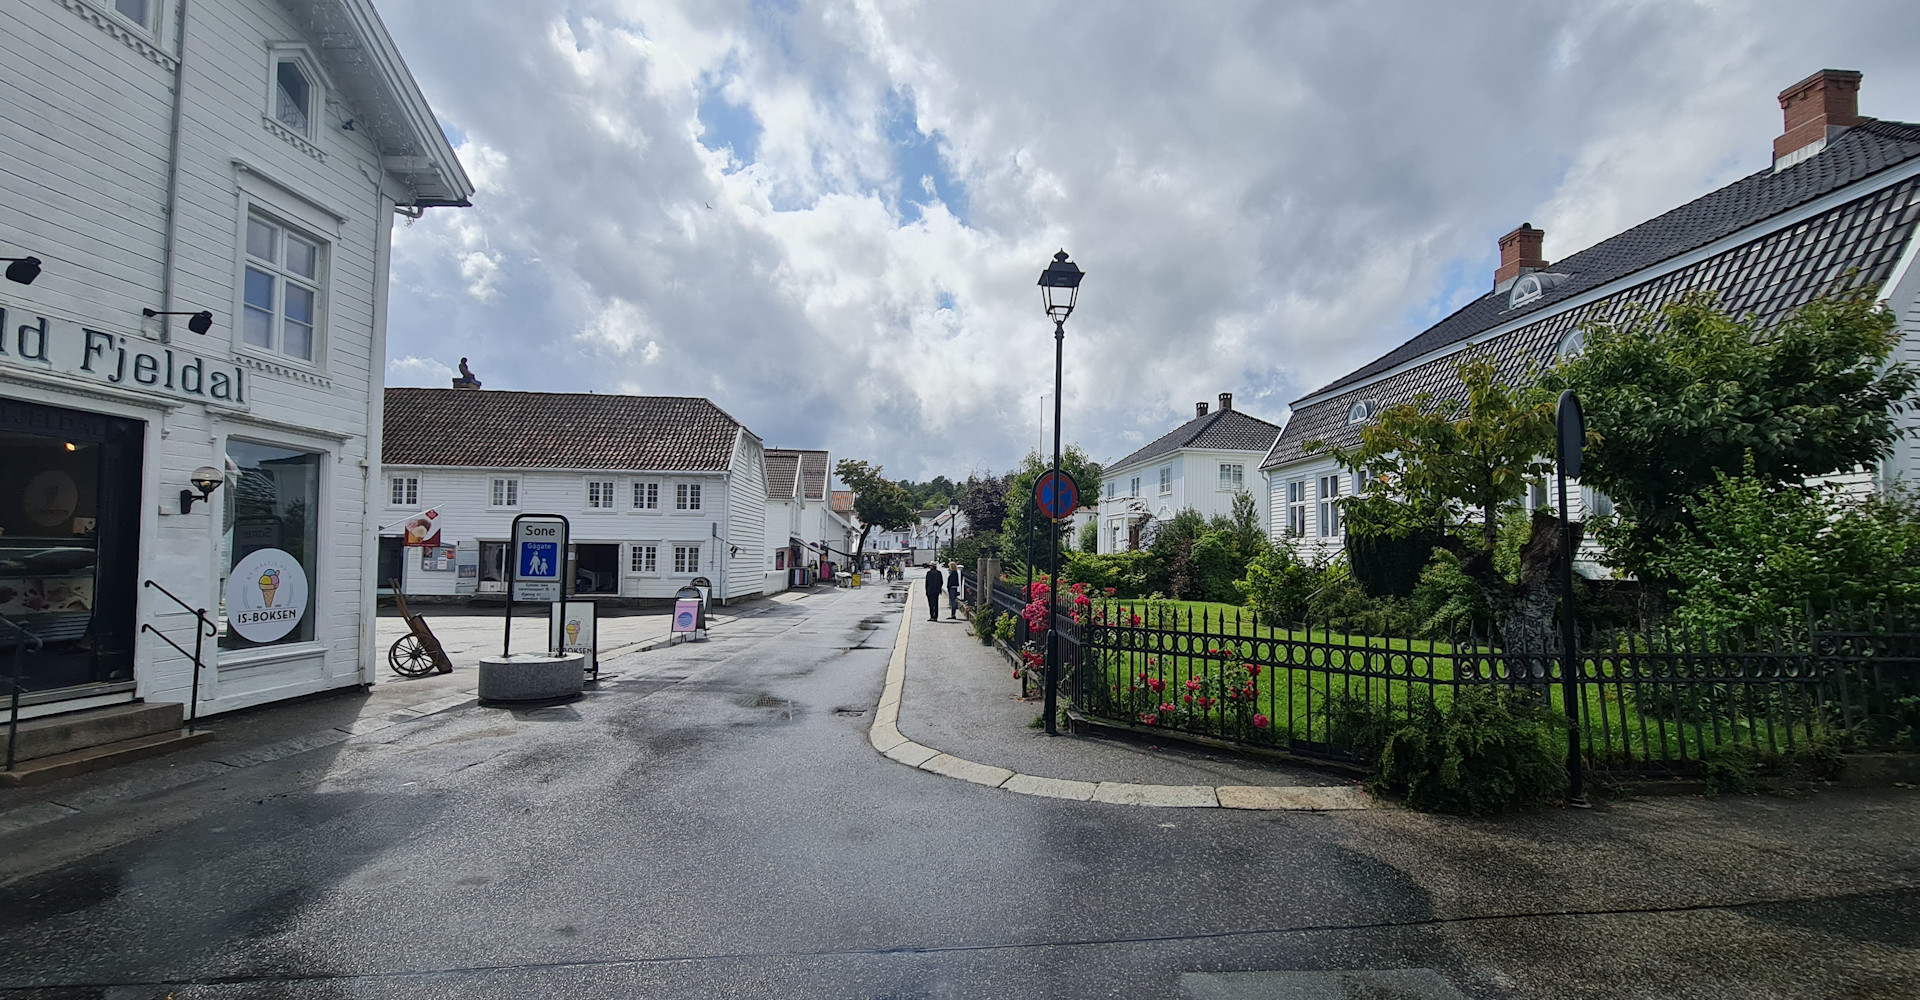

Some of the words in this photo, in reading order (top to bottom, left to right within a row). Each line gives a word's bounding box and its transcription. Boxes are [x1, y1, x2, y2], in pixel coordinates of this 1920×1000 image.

[80, 327, 247, 404] Fjeldal
[525, 525, 556, 536] Sone
[527, 543, 552, 551] Gågate
[238, 609, 297, 624] IS-BOKSEN
[553, 647, 593, 655] ISBOKSEN
